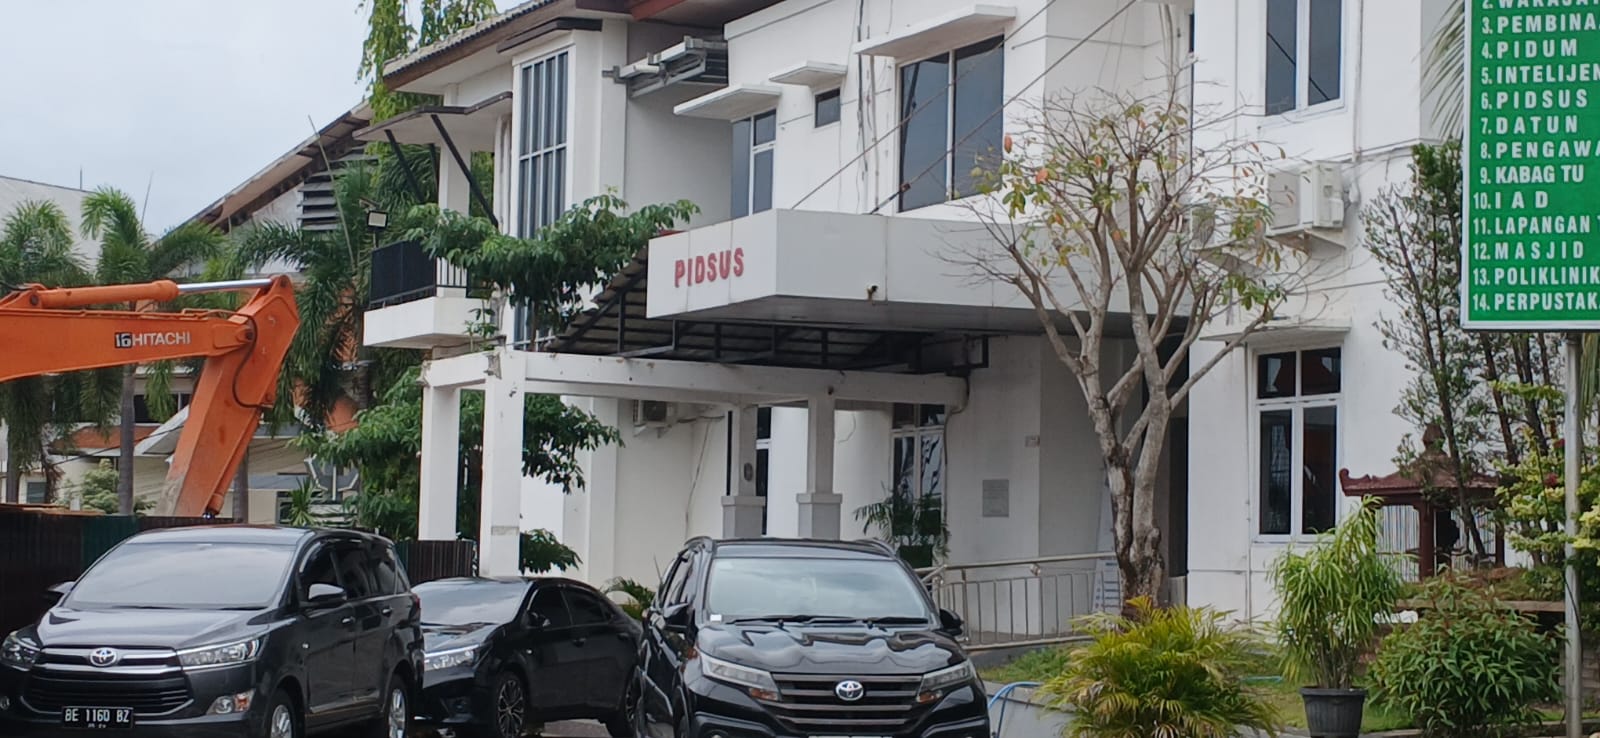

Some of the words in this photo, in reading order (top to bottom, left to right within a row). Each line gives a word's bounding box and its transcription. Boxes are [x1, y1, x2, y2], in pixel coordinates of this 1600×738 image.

[1497, 13, 1600, 33] PEMBINA
[1497, 38, 1577, 59] PIDUM
[1496, 89, 1588, 109] PIDSUS
[1496, 115, 1578, 134] DATUN
[1495, 165, 1555, 184] KABAG
[1561, 164, 1584, 182] TU
[1495, 215, 1590, 235] LAPANGAN
[1494, 241, 1584, 260] MASJID
[674, 247, 744, 288] PIDSUS
[1494, 266, 1600, 285] POLIKLINIK
[1494, 292, 1600, 311] PERPUSTAK
[132, 332, 191, 346] HITACHI
[65, 709, 79, 721] BE
[116, 709, 129, 722] BZ
